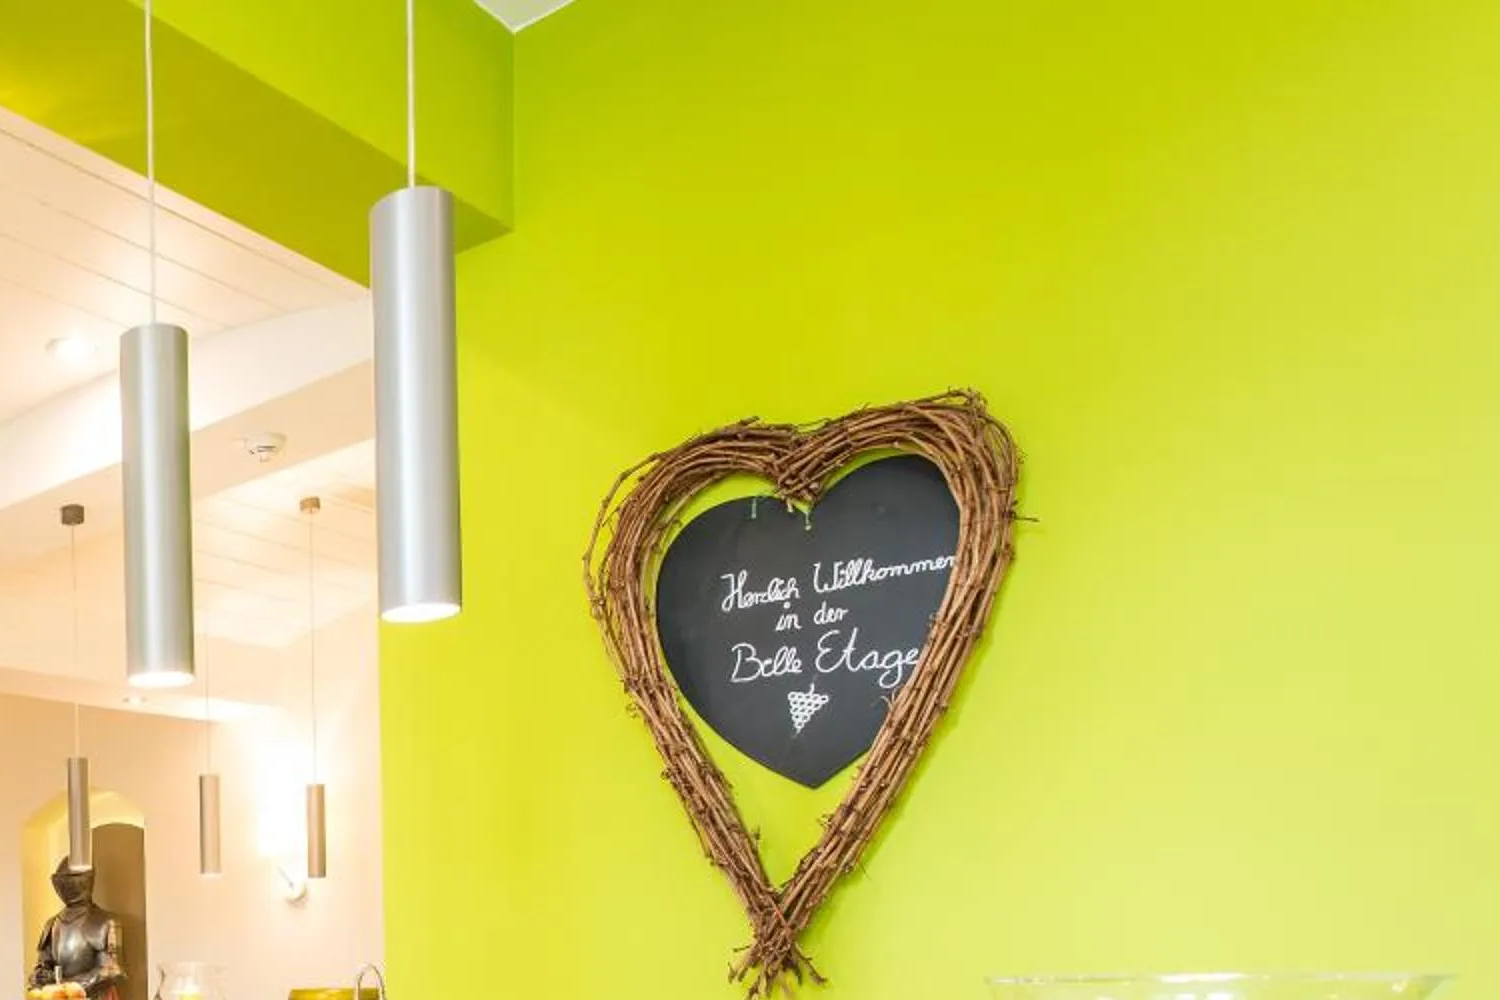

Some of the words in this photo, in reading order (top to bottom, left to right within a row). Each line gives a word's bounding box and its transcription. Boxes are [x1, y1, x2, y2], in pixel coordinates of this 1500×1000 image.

[775, 602, 801, 631] in
[813, 601, 848, 625] der
[731, 642, 802, 683] Belle
[815, 627, 919, 688] Etage
